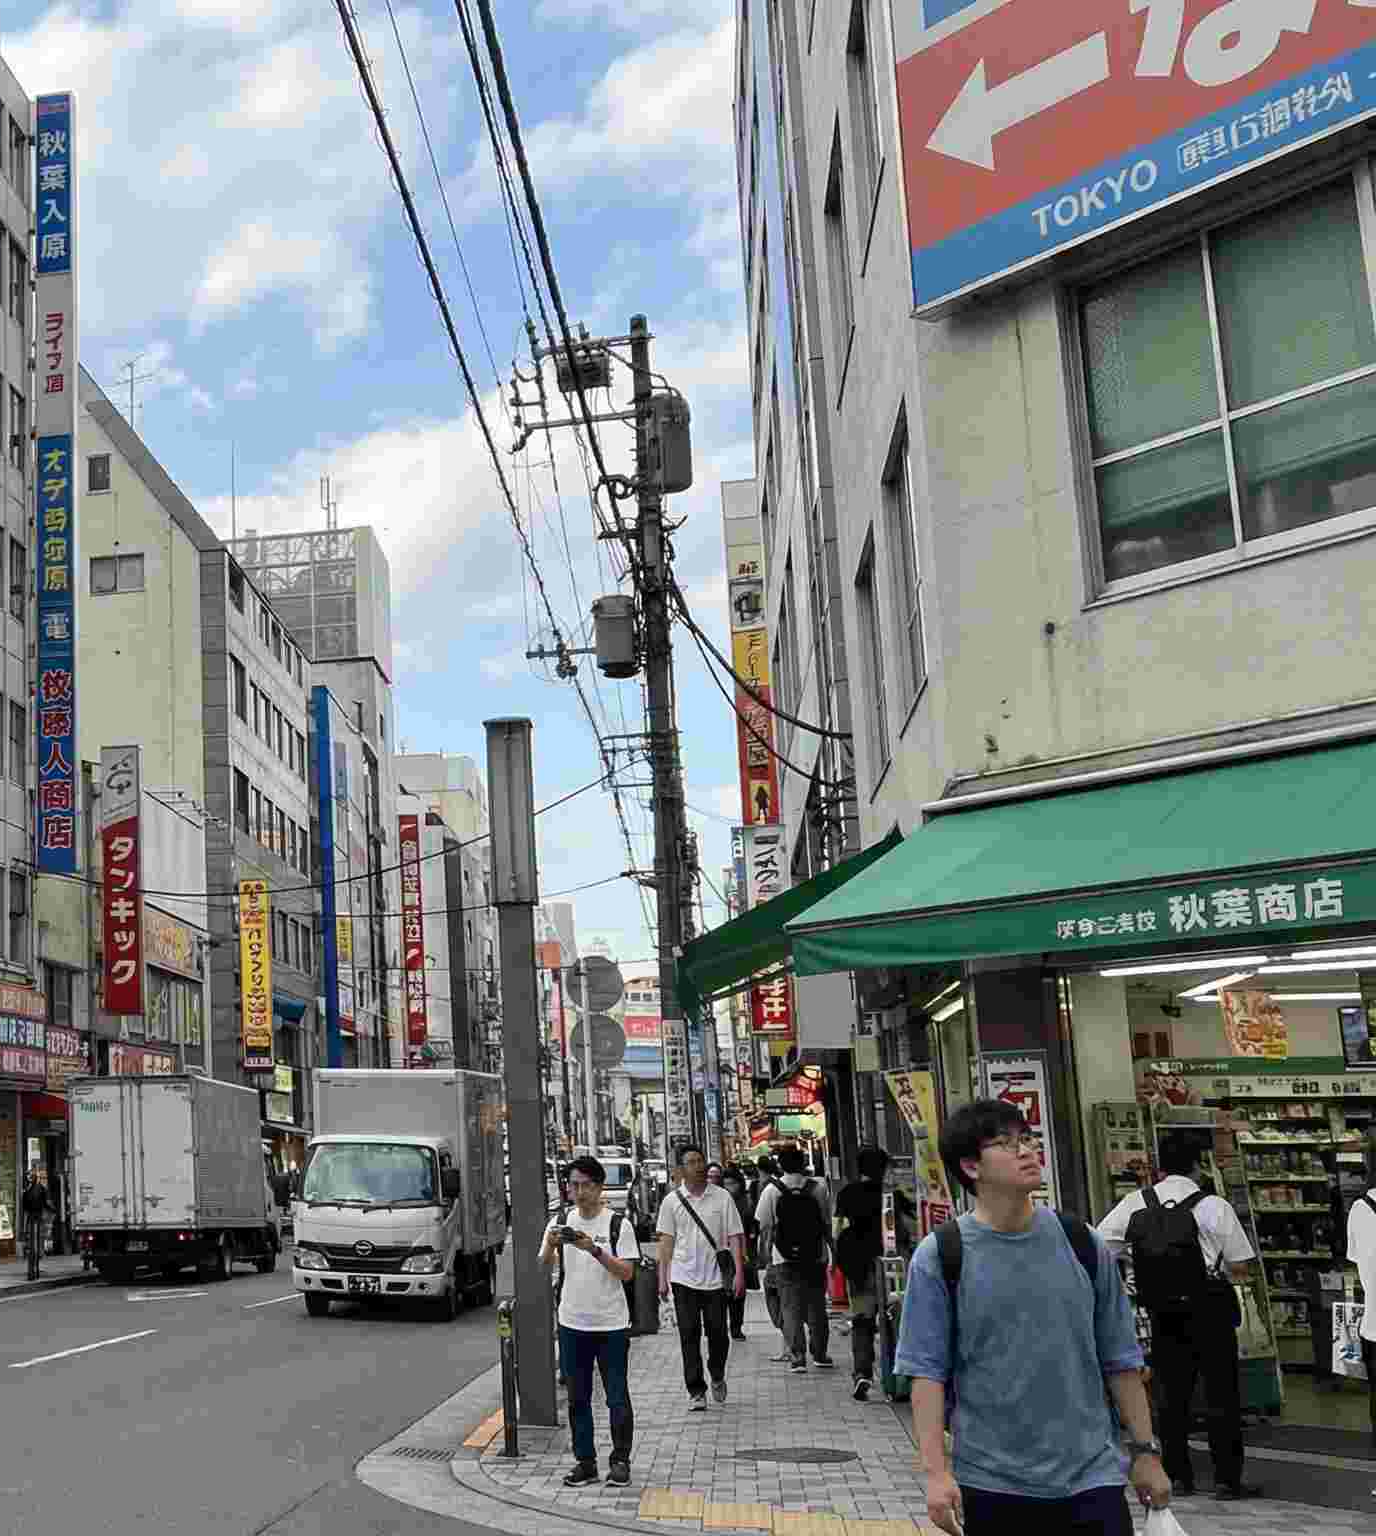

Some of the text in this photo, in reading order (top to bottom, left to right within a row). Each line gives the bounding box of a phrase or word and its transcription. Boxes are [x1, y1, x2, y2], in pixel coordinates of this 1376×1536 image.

[1031, 158, 1159, 240] TOKYO
[1167, 878, 1345, 933] 秋葉商店
